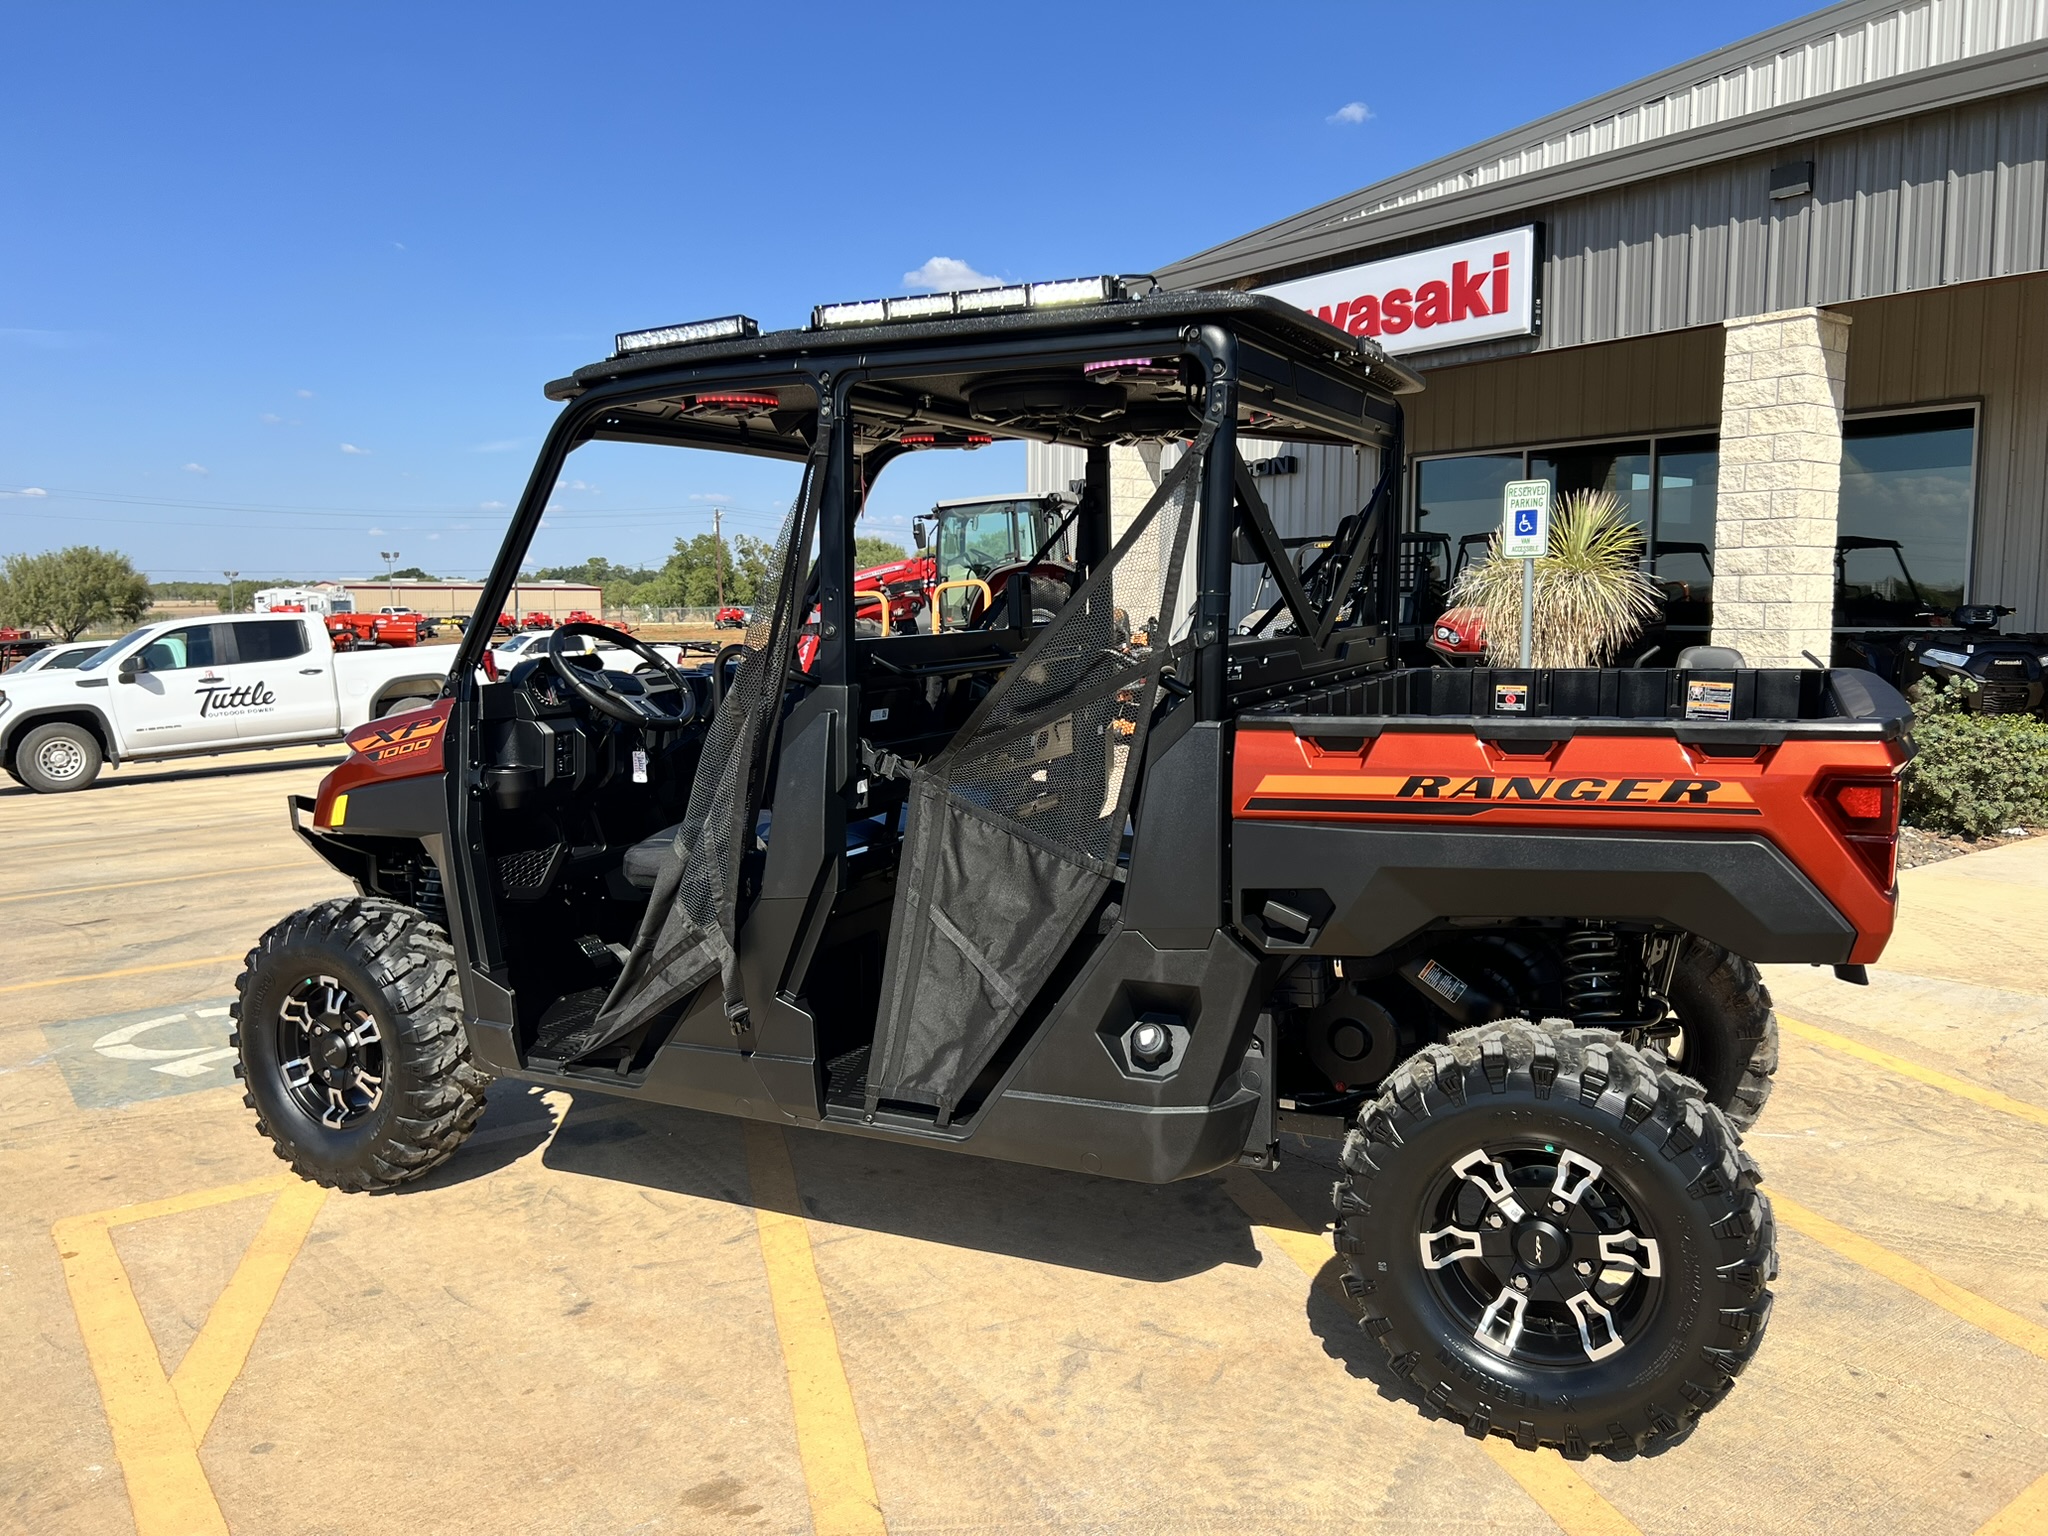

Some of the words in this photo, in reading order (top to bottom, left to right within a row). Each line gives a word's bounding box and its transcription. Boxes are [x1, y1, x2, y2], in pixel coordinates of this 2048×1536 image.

[1303, 250, 1510, 337] wasaki
[1508, 486, 1547, 497] RESERVED
[1510, 498, 1544, 508] PARKING
[194, 680, 276, 718] Tuttle
[208, 709, 245, 718] OUTDOOR
[247, 707, 275, 715] POWER
[363, 715, 443, 750] XP
[377, 738, 432, 760] 1000
[1395, 775, 1722, 805] RANGER
